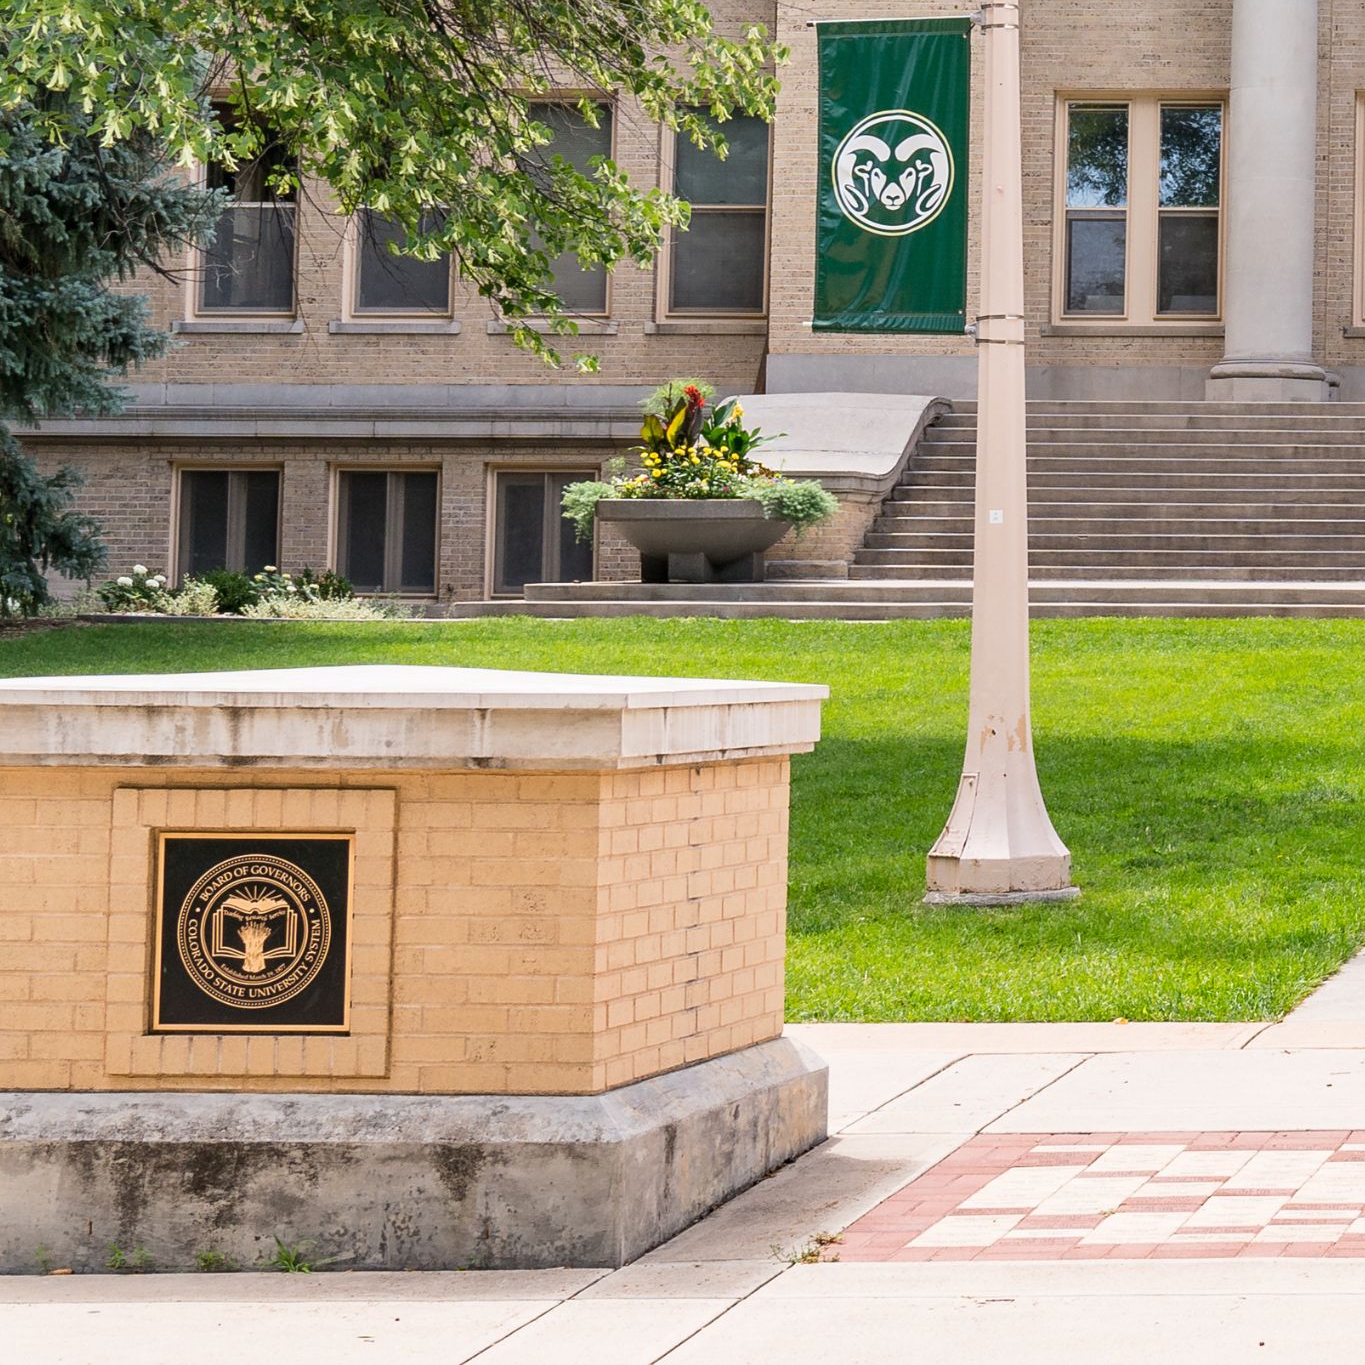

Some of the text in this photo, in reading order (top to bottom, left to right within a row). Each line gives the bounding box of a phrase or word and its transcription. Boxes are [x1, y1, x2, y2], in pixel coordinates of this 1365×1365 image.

[199, 865, 311, 902] BOARD OF GOVERNORS
[188, 918, 321, 998] COLORADO STATE UNIVERSITY SYSTEM
